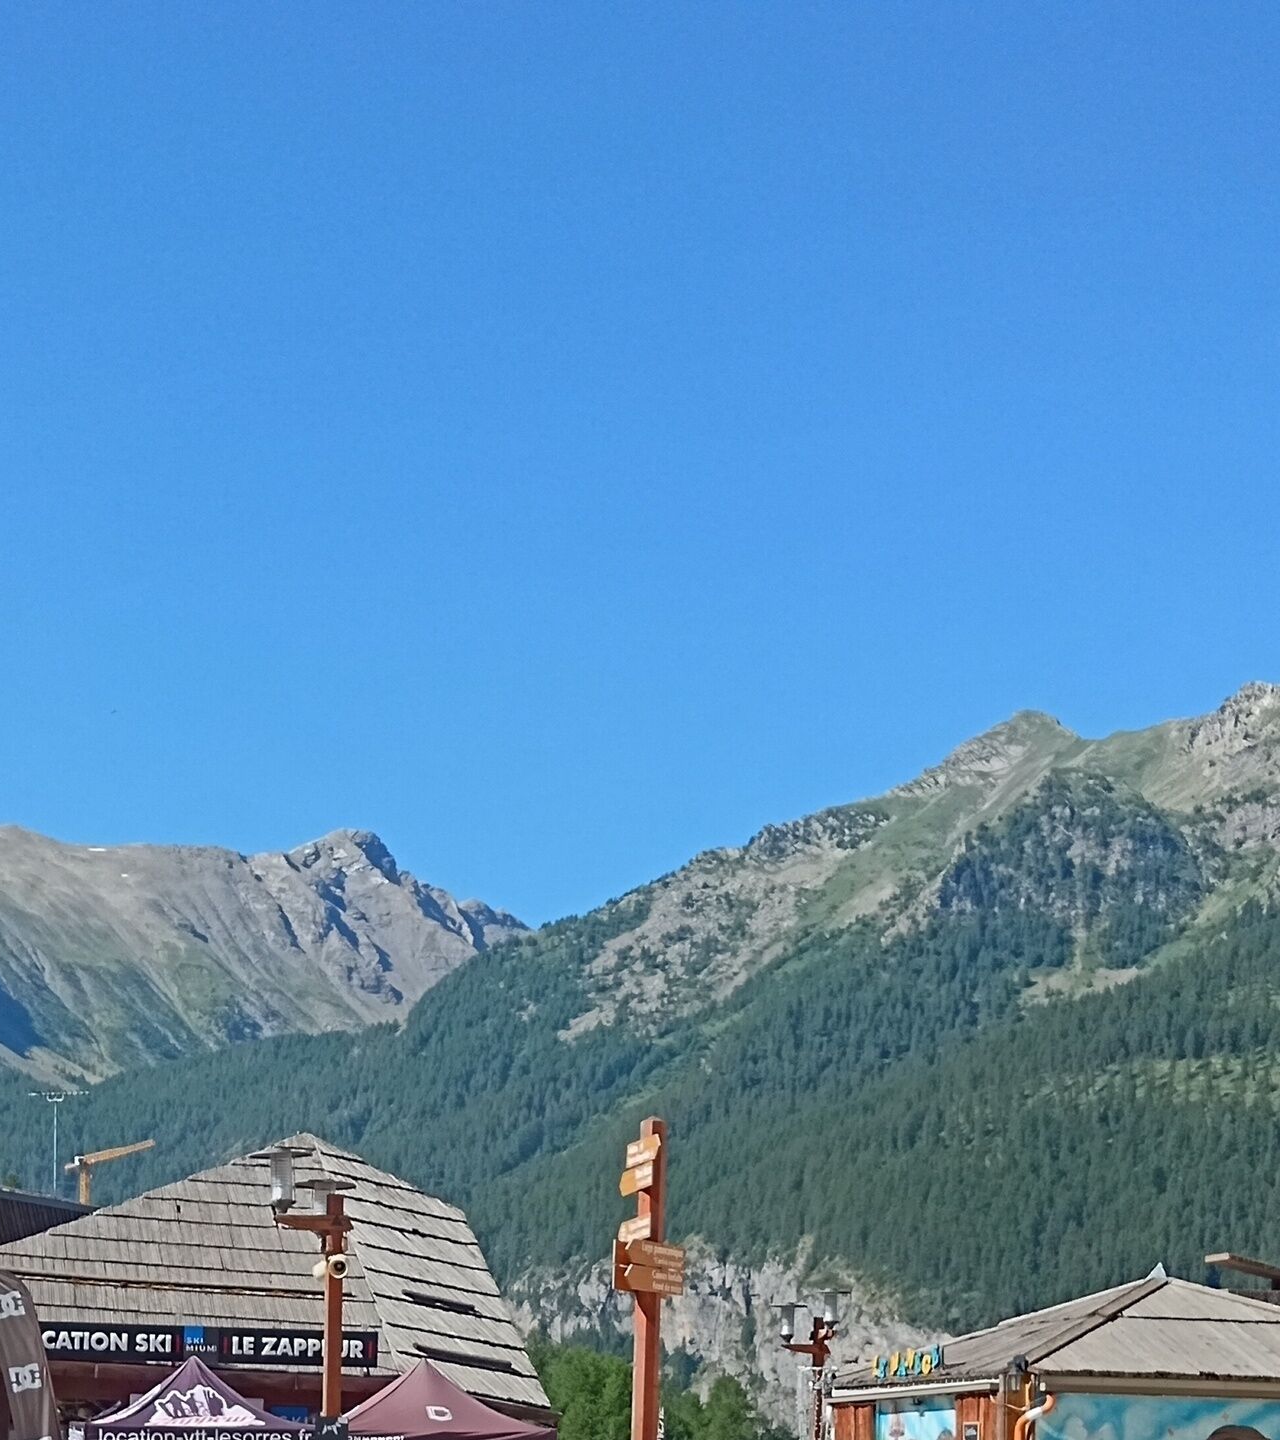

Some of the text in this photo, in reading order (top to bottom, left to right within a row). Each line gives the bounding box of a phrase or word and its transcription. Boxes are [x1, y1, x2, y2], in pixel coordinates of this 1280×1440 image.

[41, 1330, 172, 1353] CATION SKI
[186, 1336, 204, 1344] SKI
[231, 1336, 364, 1359] LE ZAPPUR
[8, 1363, 42, 1393] DC
